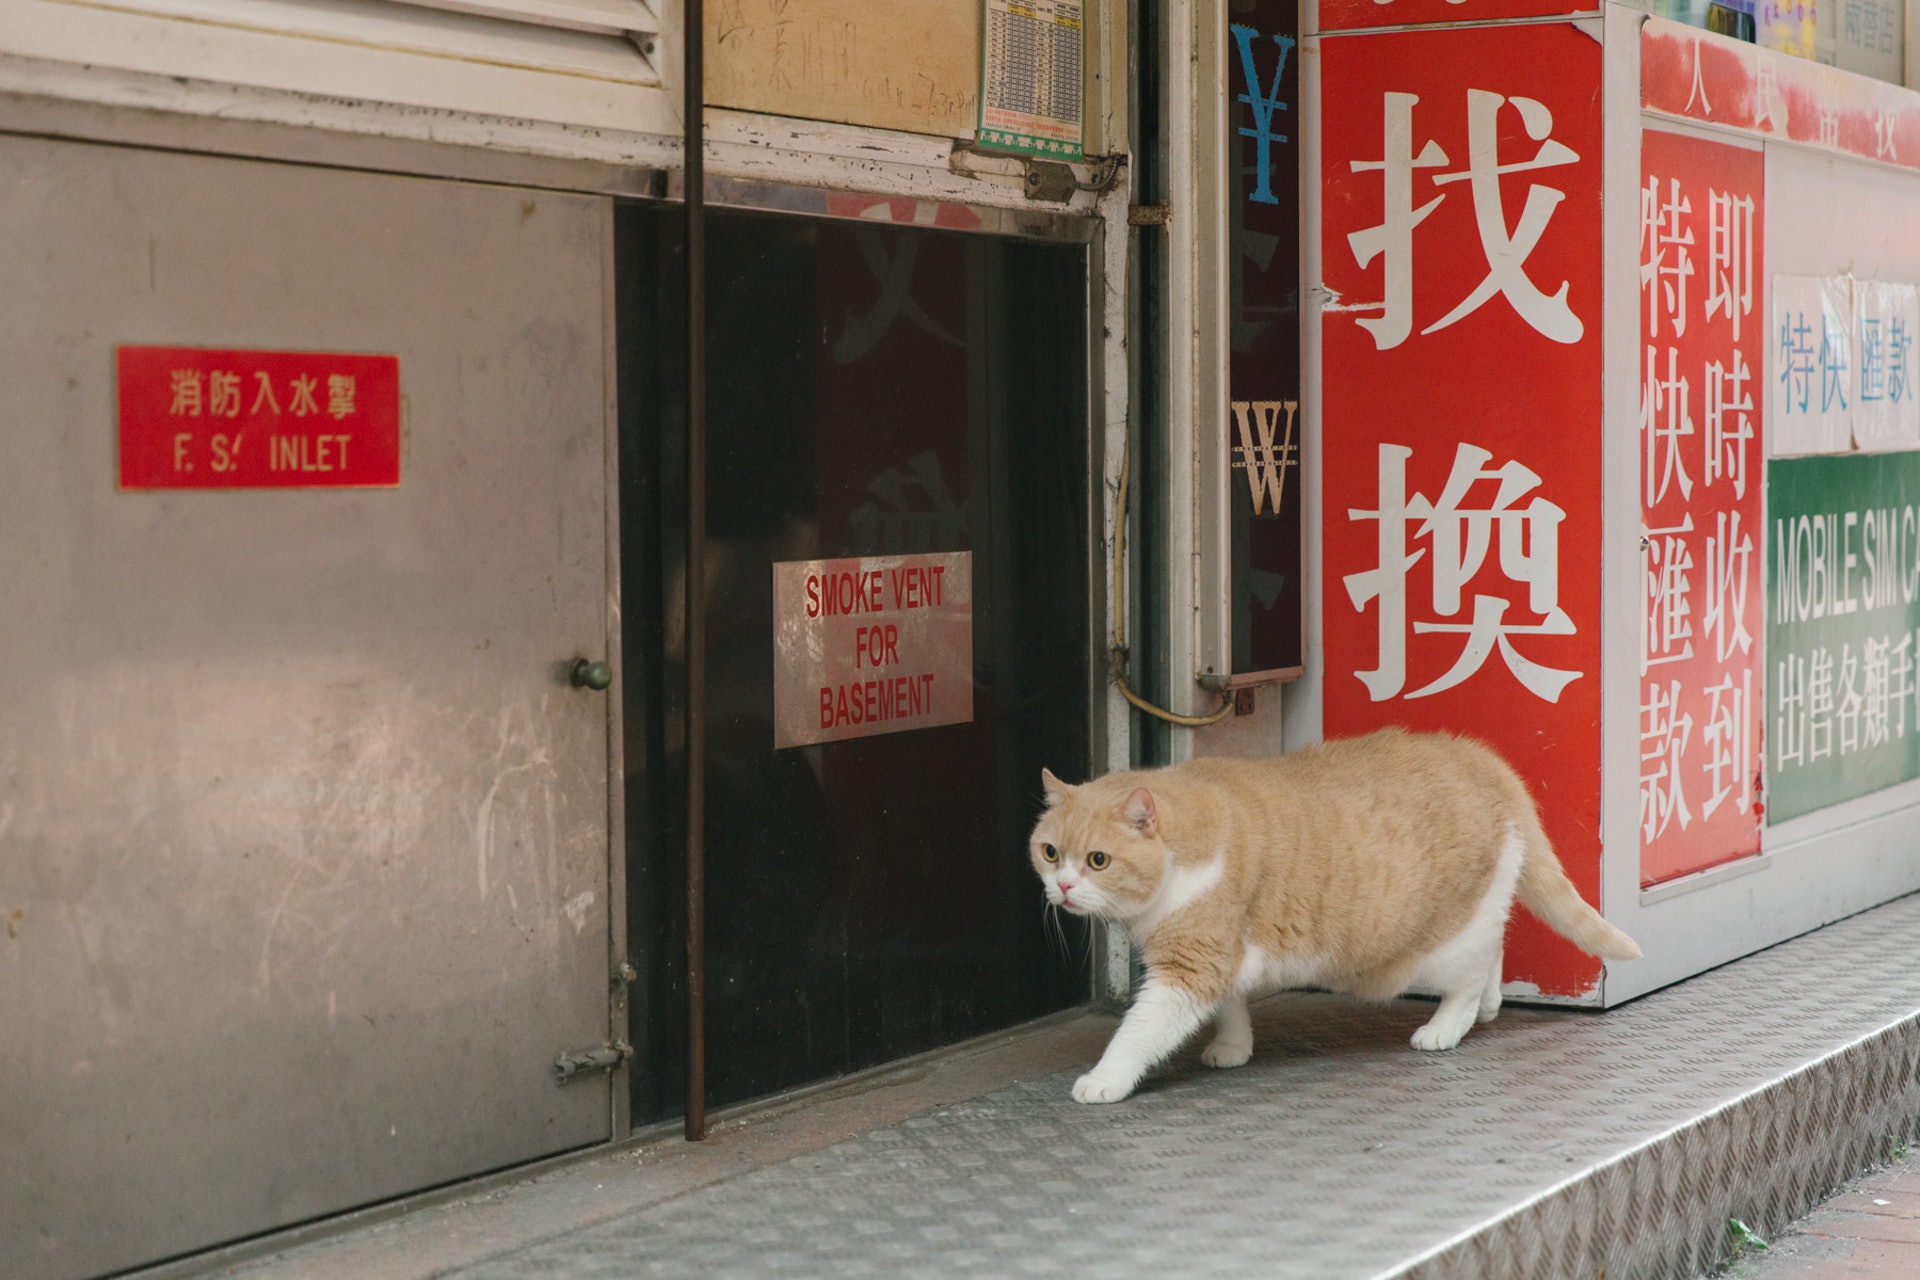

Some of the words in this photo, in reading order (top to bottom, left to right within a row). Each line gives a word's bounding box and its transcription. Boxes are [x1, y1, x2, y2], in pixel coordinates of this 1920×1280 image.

[270, 434, 351, 471] INLET
[1342, 88, 1585, 704] 找換
[1641, 174, 1695, 845] 特快匯款
[1703, 186, 1756, 823] 即時收到
[806, 570, 883, 618] SMOKE
[892, 566, 945, 610] VENT
[1776, 511, 1857, 625] MOBILE
[1862, 507, 1897, 612] SIM
[820, 673, 934, 729] BASEMENT
[856, 624, 899, 669] FOR
[1778, 626, 1920, 773] 出售各類手
